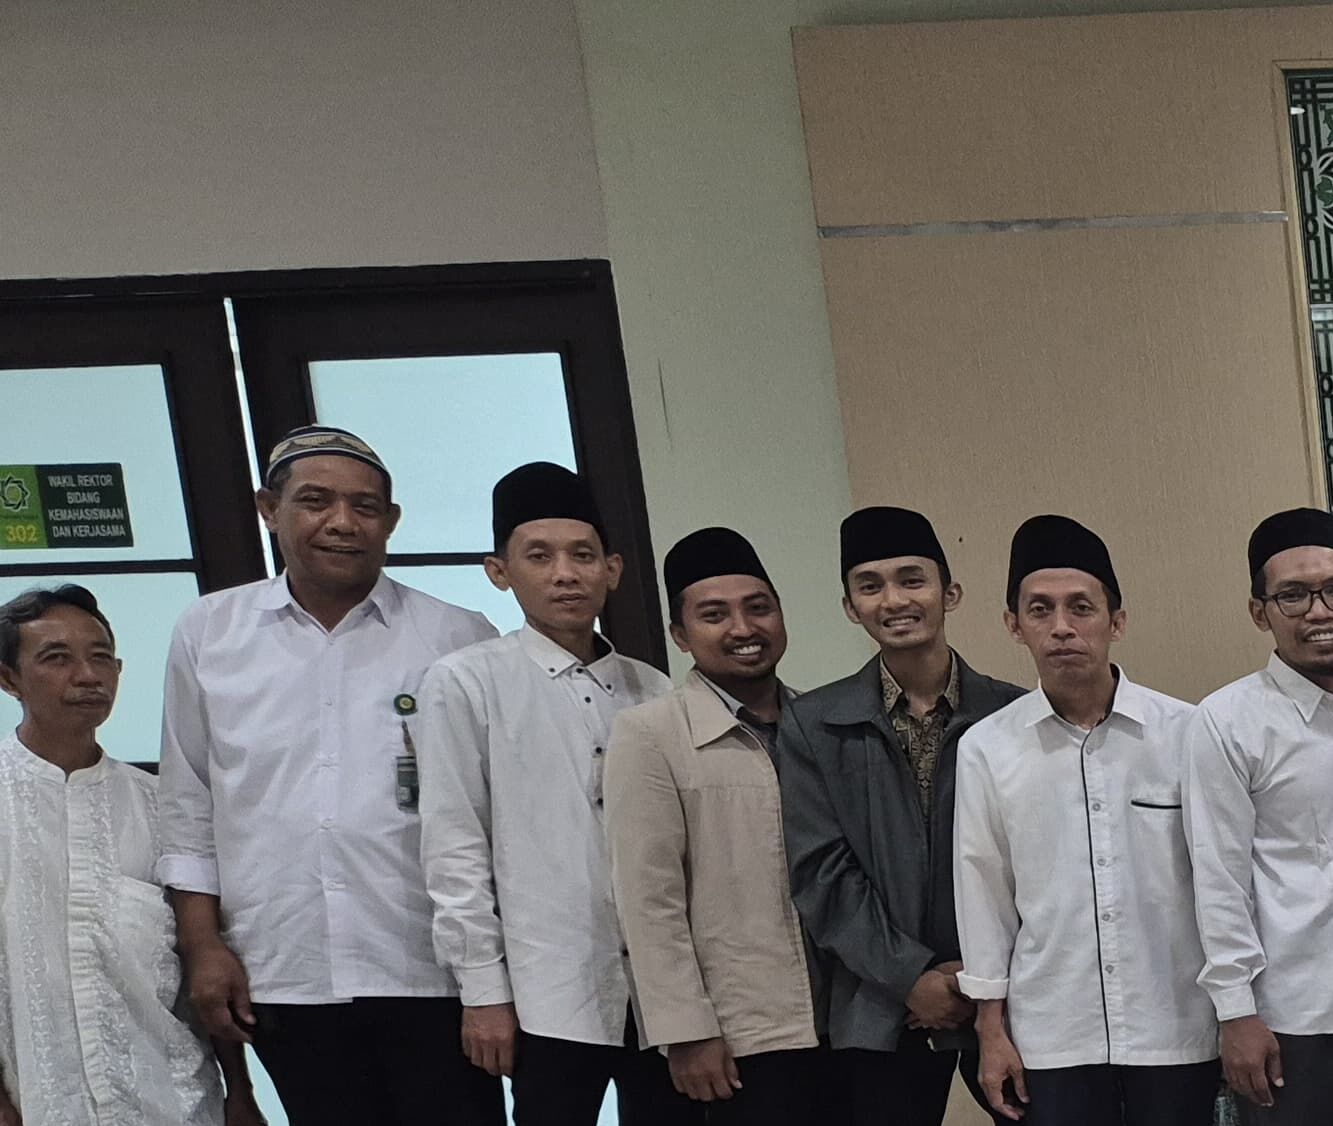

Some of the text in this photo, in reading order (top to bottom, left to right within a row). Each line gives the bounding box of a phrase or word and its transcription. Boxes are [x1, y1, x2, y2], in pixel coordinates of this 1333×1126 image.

[47, 474, 114, 488] WAKIL REKTOR
[66, 491, 100, 504] BIDANG
[47, 508, 124, 521] KEMAHASISWAAN
[6, 524, 38, 542] 302
[52, 525, 126, 538] DAN KERJASAMA
